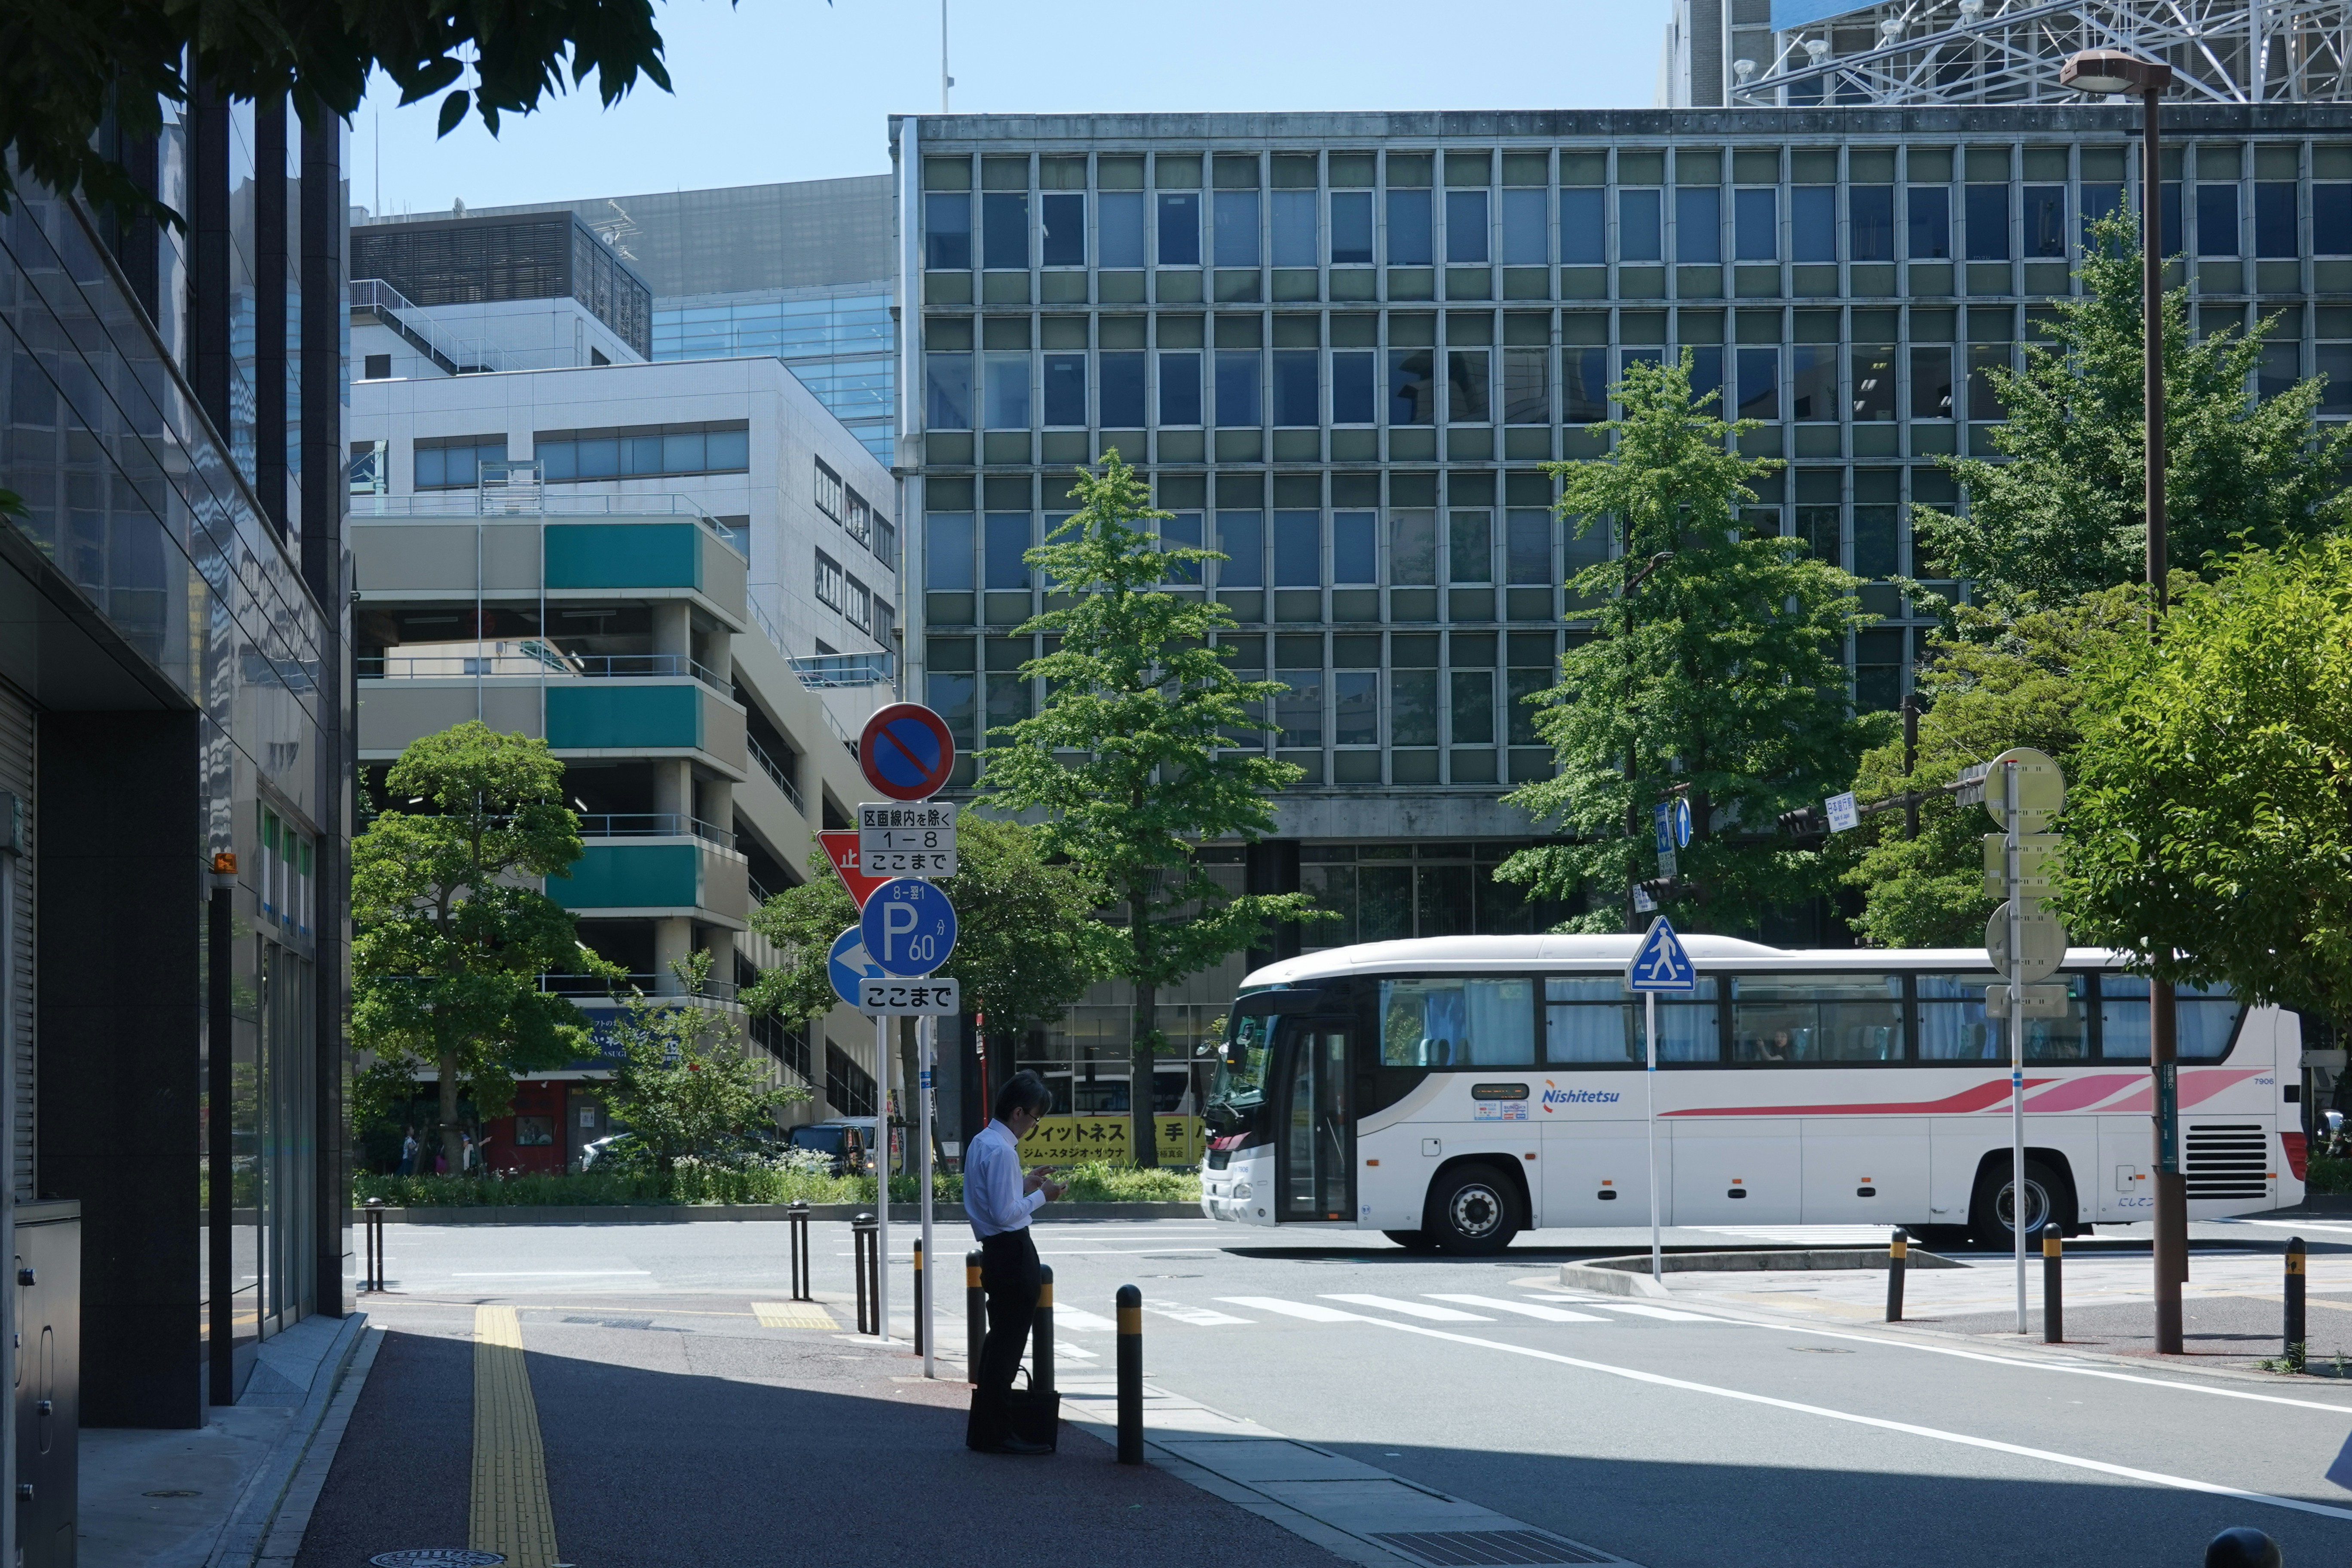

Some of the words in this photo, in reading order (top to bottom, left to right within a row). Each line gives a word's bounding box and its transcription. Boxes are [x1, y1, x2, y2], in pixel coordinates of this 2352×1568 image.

[1828, 797, 1853, 815] 日本銀行前
[864, 809, 949, 827] 区画線内を除く
[873, 854, 946, 870] ここまで
[884, 902, 918, 961] P
[868, 987, 951, 1007] ここまで
[1542, 1090, 1620, 1103] Nishitetsu
